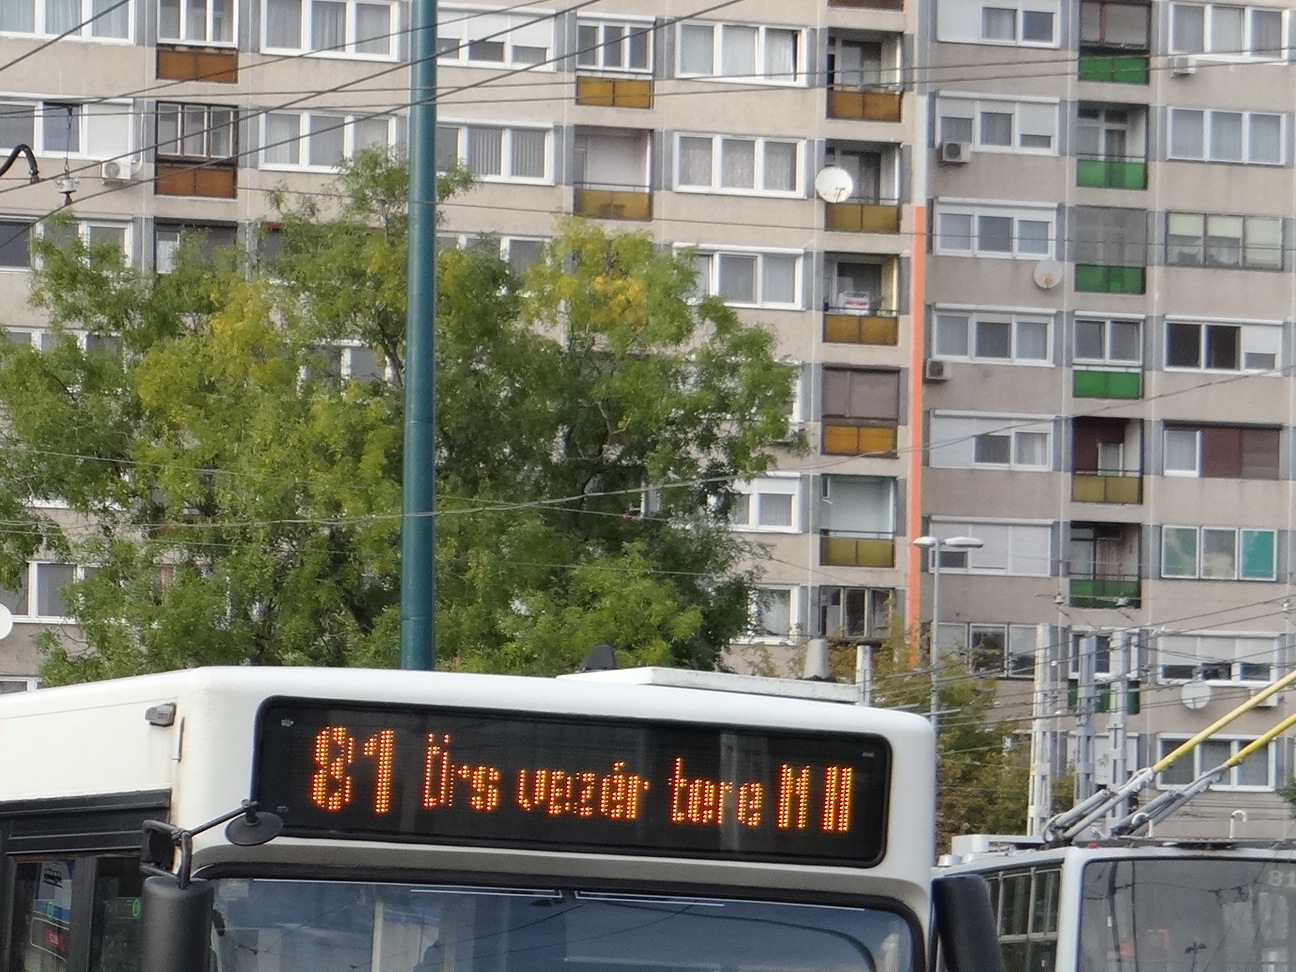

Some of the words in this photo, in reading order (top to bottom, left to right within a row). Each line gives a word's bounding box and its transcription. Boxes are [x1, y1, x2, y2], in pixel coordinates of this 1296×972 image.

[311, 725, 395, 813] 81
[517, 760, 651, 819] vezér
[668, 757, 764, 826] tere
